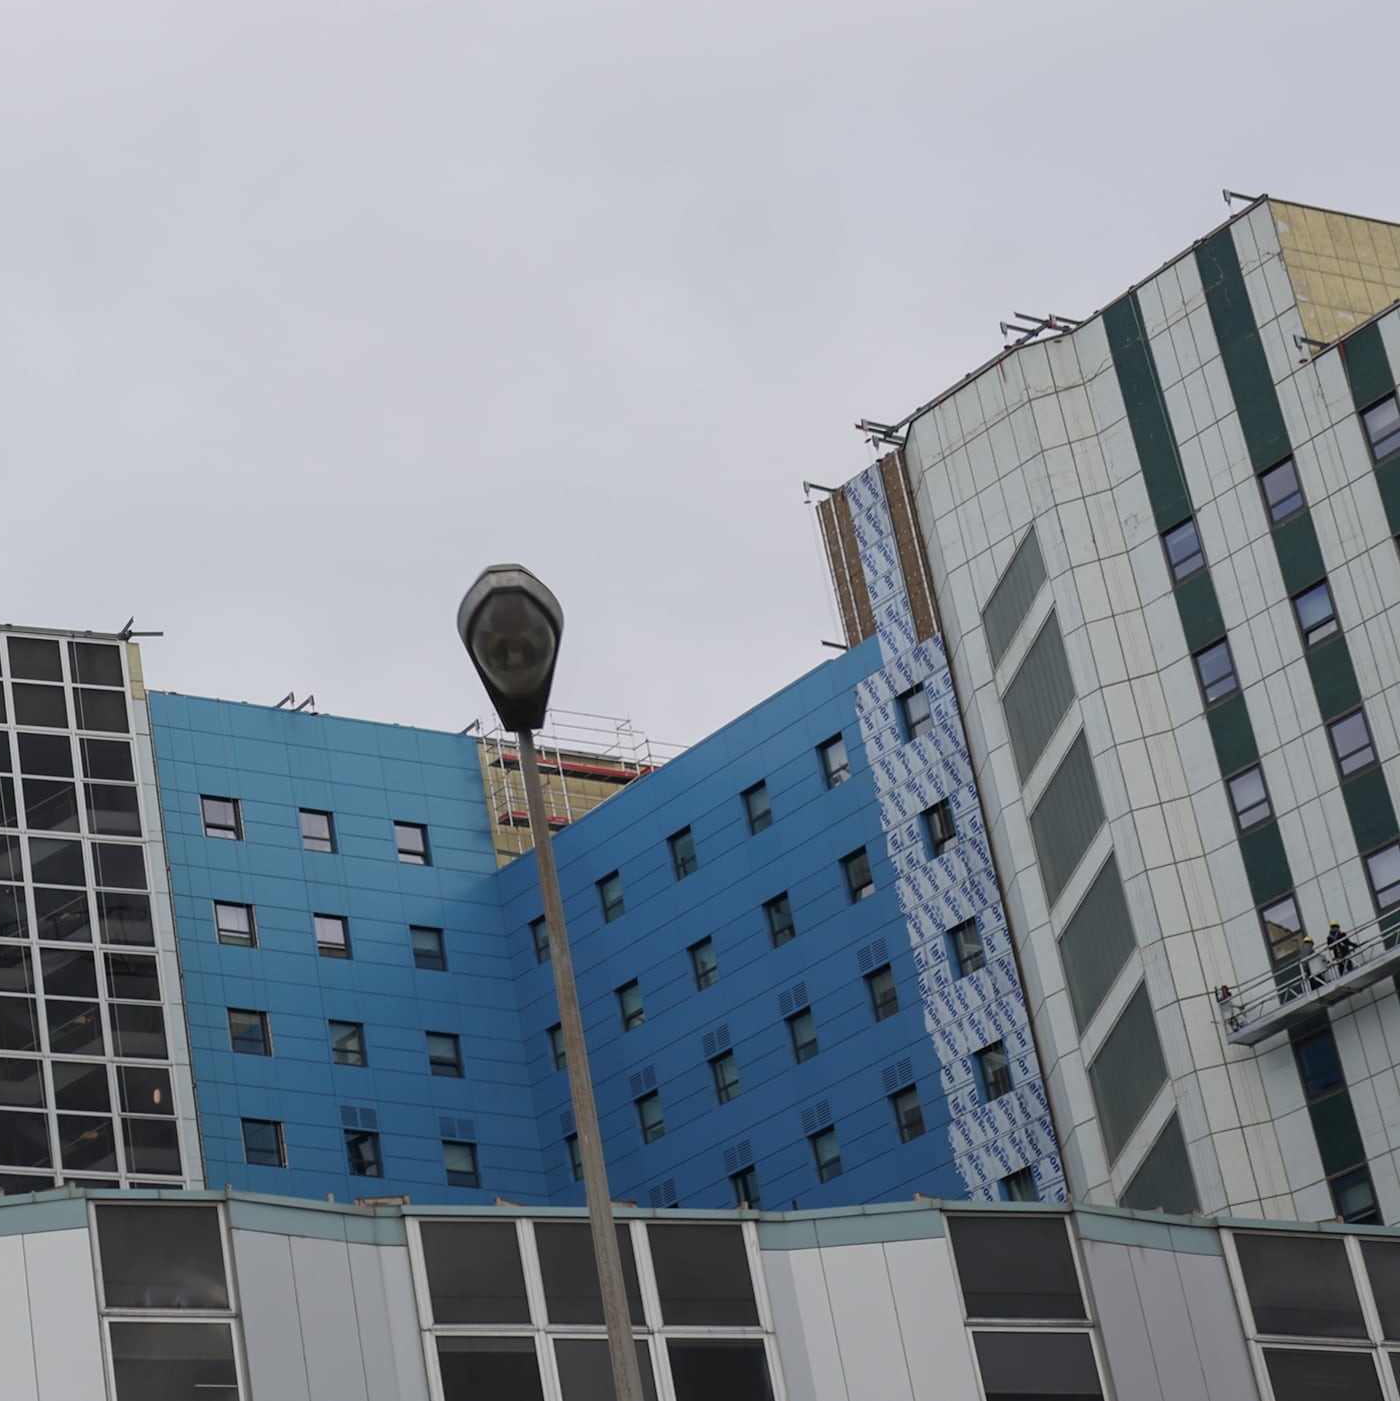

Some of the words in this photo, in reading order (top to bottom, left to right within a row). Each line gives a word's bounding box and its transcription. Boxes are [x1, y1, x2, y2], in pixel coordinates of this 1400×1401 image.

[852, 523, 868, 548] arson
[861, 553, 878, 577] arson
[877, 542, 895, 567] arson
[881, 629, 899, 655] arson
[898, 619, 916, 645] arson
[917, 645, 935, 672] arson
[863, 679, 881, 704] arson
[879, 669, 898, 696] arson
[911, 740, 929, 767] arson
[879, 759, 897, 785] arson
[943, 759, 962, 786] arson
[889, 791, 907, 817] arson
[921, 865, 940, 892] arson
[938, 856, 957, 883] arson
[904, 874, 923, 902] arson
[969, 879, 988, 906] arson
[906, 913, 925, 940] arson
[922, 903, 942, 931] arson
[998, 959, 1018, 988] arson
[968, 974, 987, 1003] arson
[923, 999, 941, 1027] arson
[939, 990, 958, 1018] arson
[997, 999, 1017, 1029] arson
[941, 1029, 959, 1058] arson
[1029, 1082, 1050, 1113] arson
[980, 1106, 999, 1135] arson
[997, 1098, 1017, 1127] arson
[955, 1119, 974, 1147] arson
[967, 1153, 987, 1182] arson
